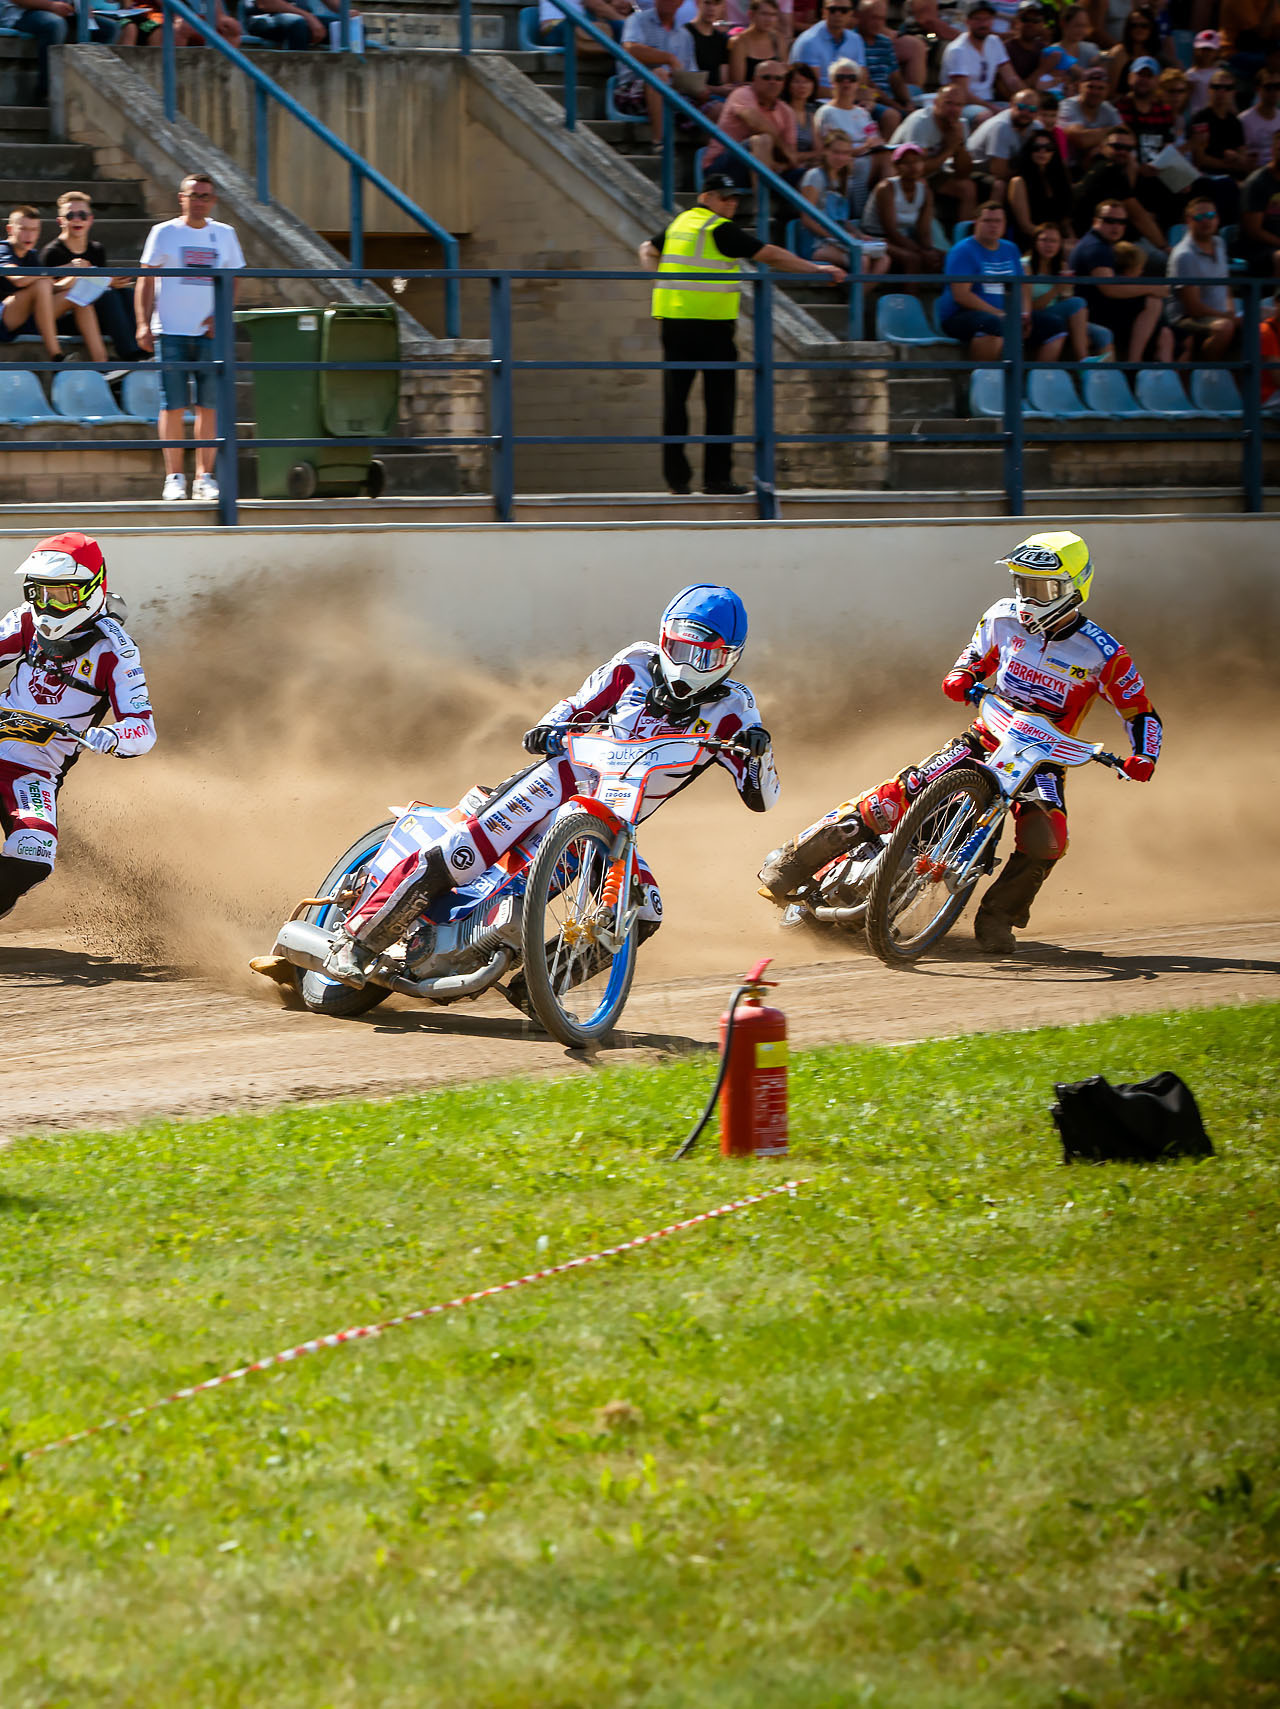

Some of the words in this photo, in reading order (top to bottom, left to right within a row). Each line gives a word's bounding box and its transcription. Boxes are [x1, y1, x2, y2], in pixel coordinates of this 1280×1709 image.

[1080, 623, 1116, 656] Nice
[1007, 660, 1067, 695] ABRAMCZYK
[1013, 720, 1059, 746] ABRAMCZYK
[42, 790, 52, 812] BAR
